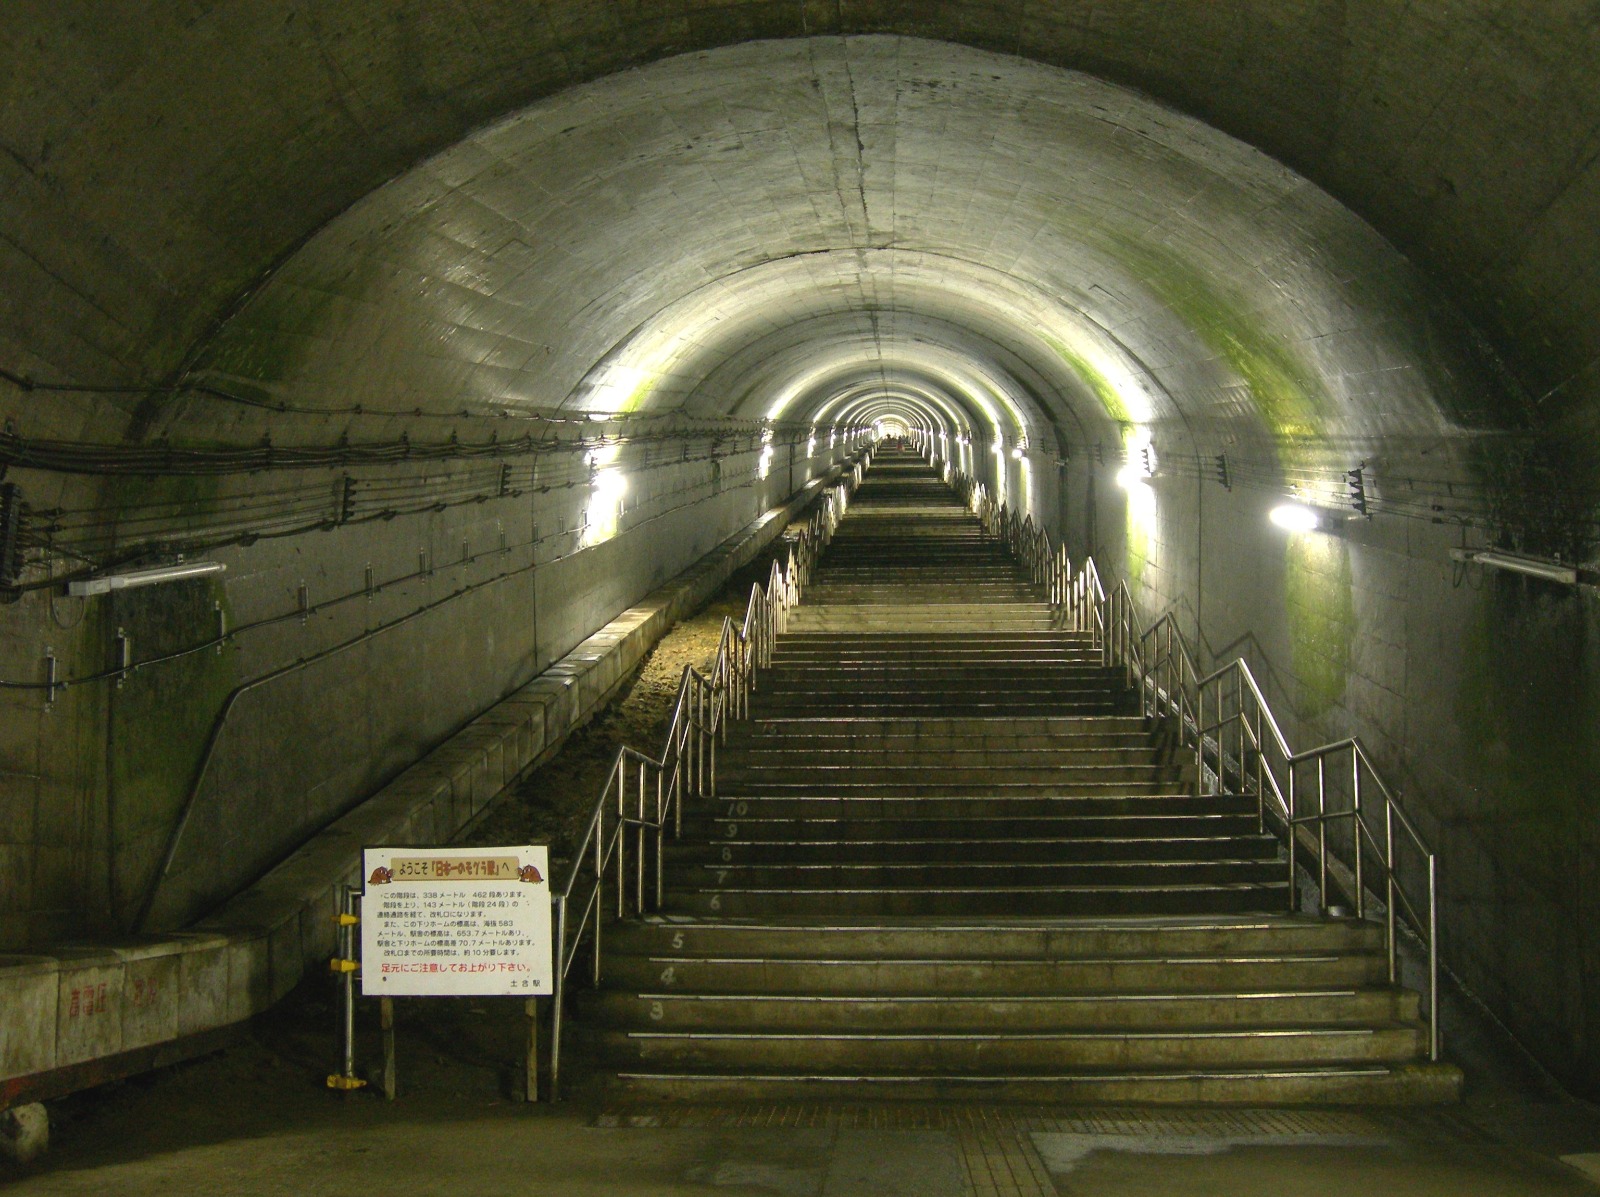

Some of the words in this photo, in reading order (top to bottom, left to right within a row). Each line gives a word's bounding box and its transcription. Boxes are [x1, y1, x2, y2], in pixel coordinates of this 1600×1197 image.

[728, 802, 748, 816] 10
[725, 824, 738, 838] 9
[722, 847, 732, 861] 8
[716, 871, 728, 884] 7
[710, 895, 721, 910] 6
[672, 933, 685, 949] 5
[381, 962, 532, 973] 足元にご注意してお上がり下さい。
[660, 966, 676, 985] 4
[649, 1001, 664, 1020] 3
